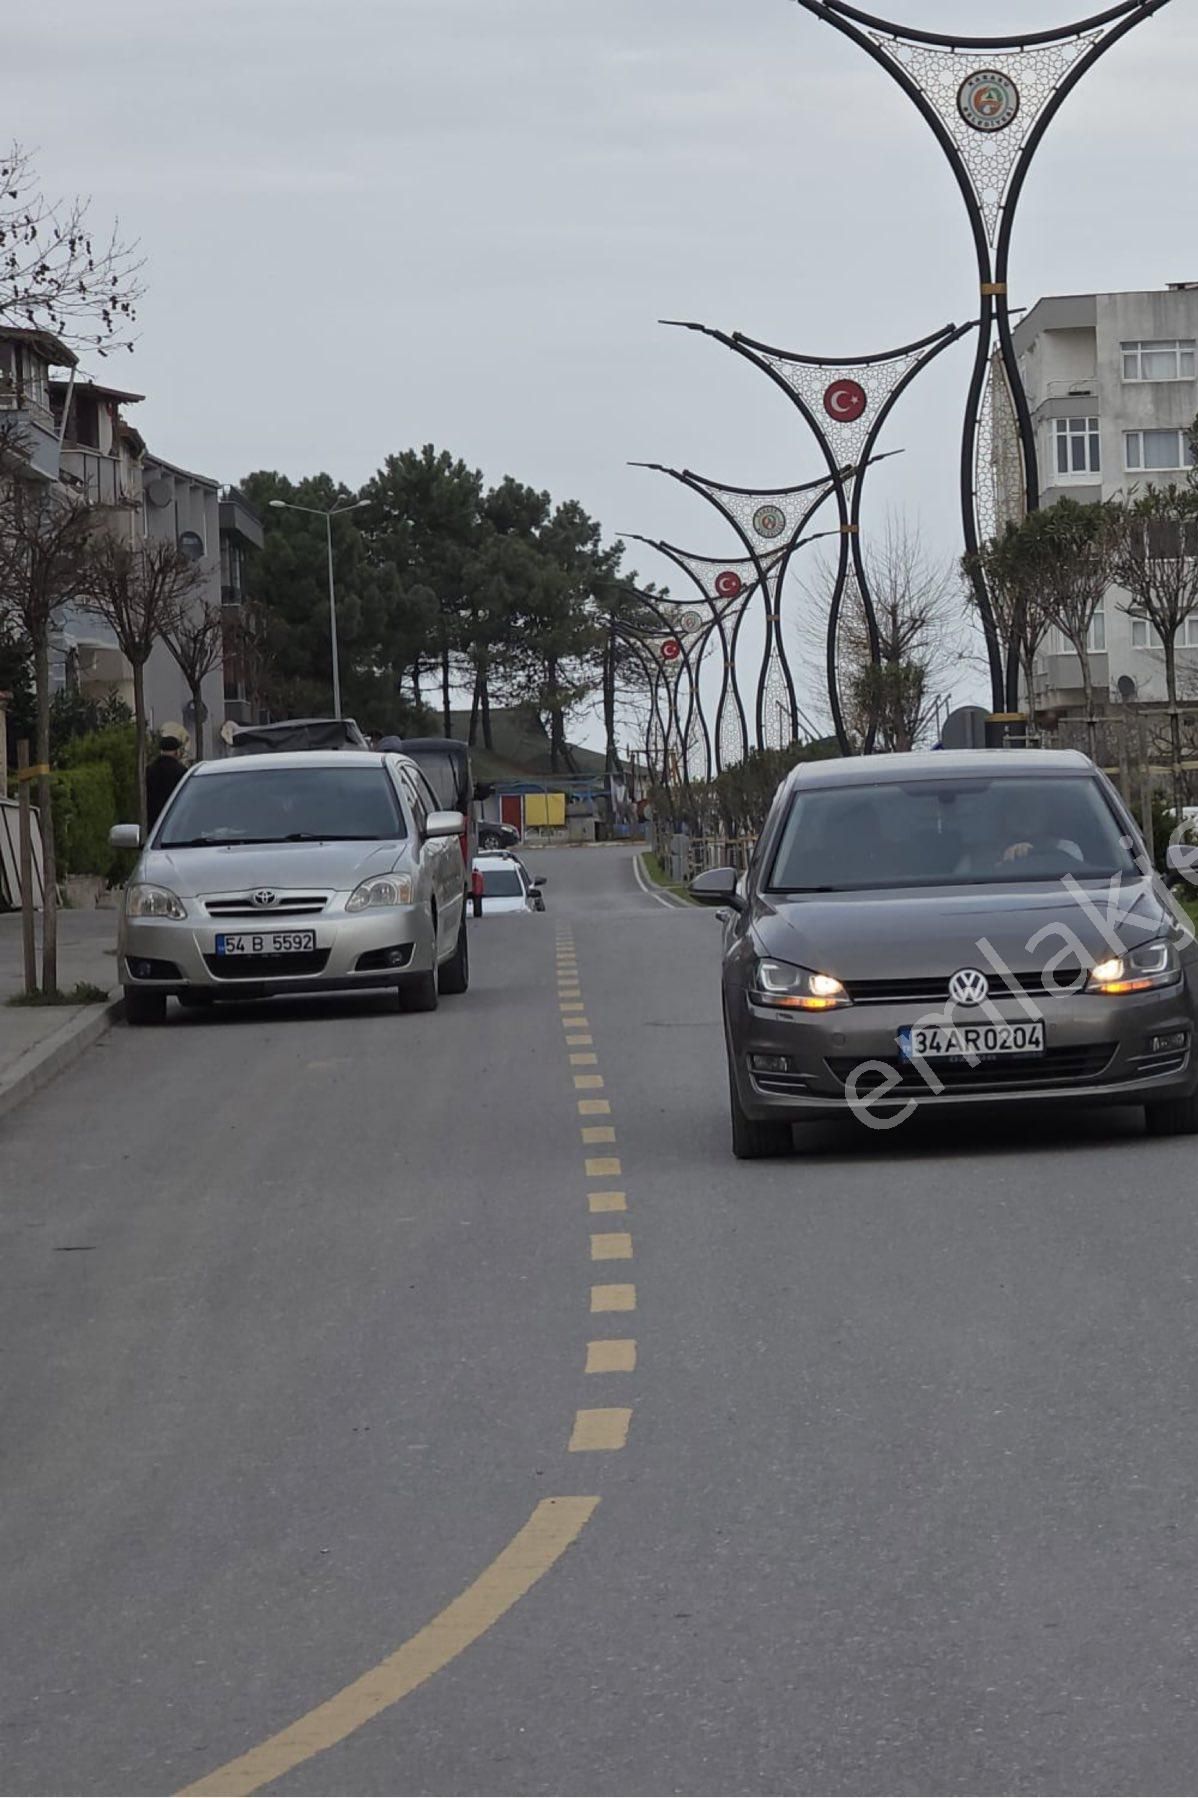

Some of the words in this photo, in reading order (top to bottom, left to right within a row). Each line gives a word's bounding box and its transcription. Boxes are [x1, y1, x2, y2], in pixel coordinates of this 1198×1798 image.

[226, 937, 245, 953] 54
[252, 936, 263, 952] B
[273, 935, 312, 951] 5592
